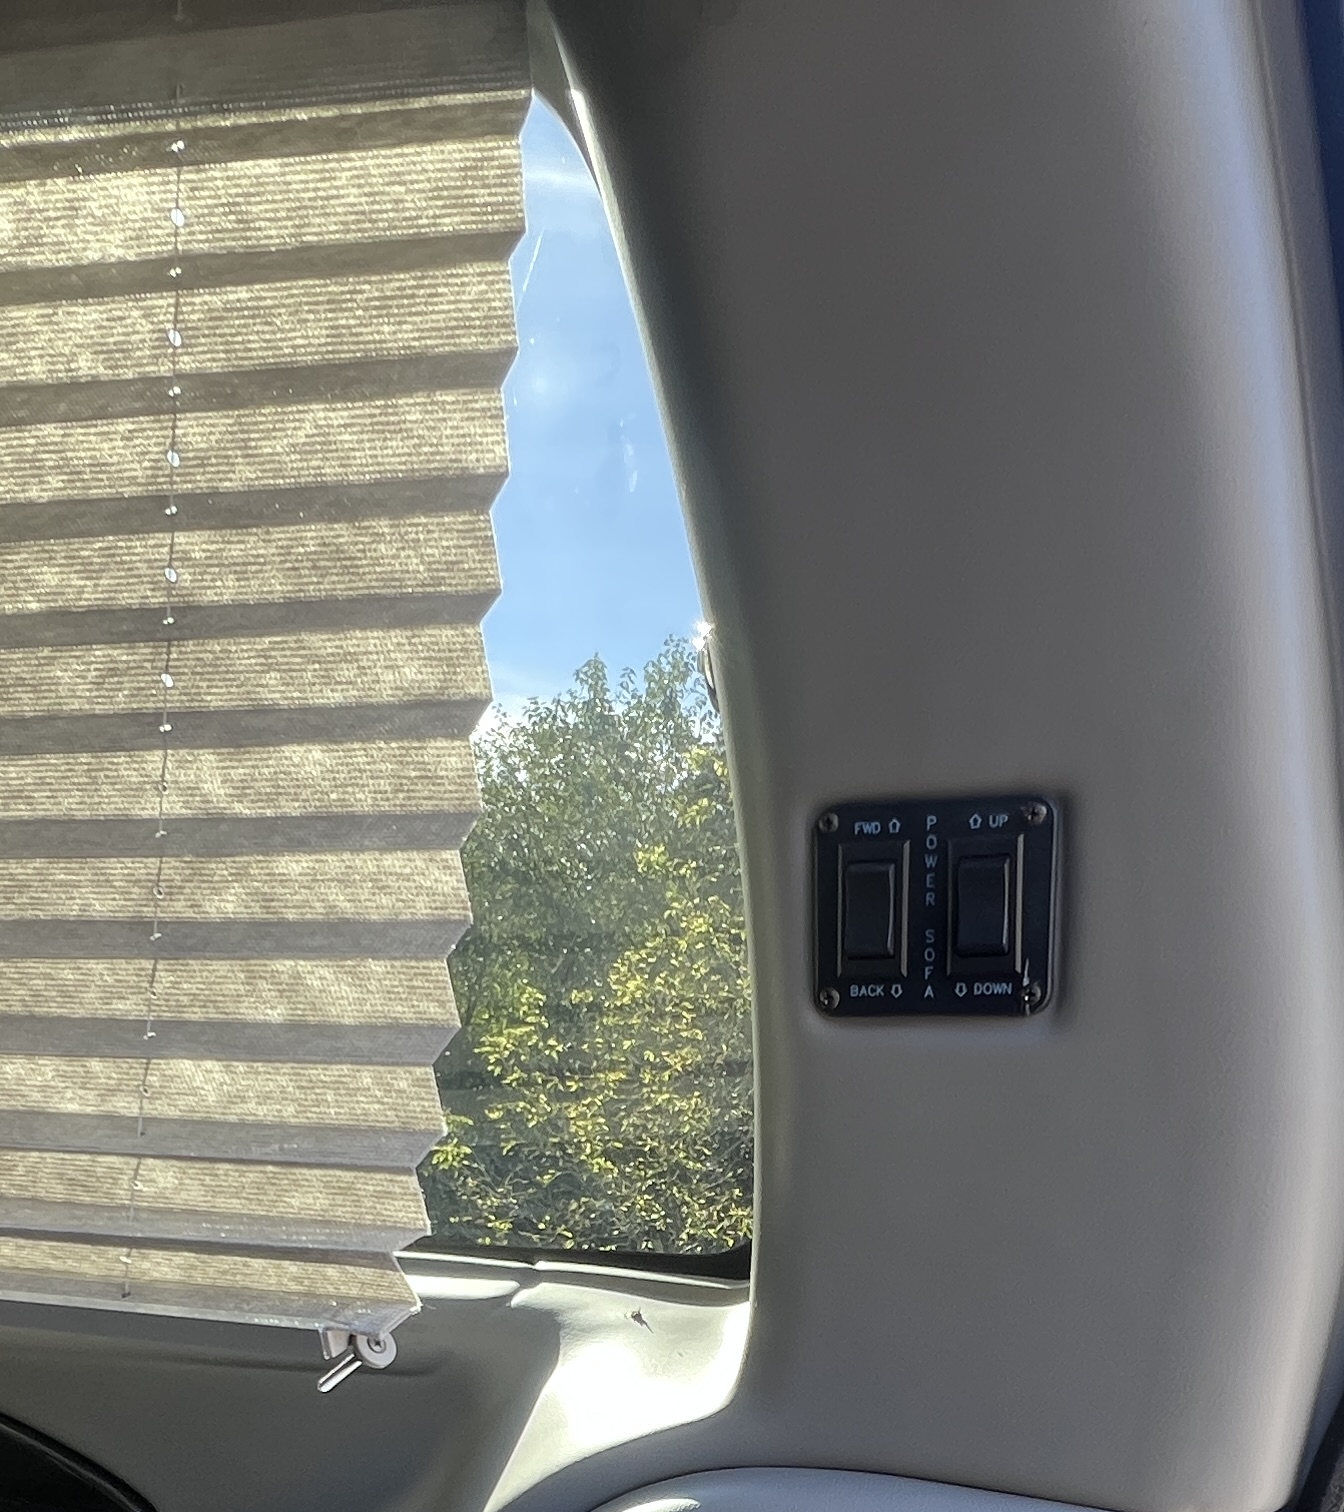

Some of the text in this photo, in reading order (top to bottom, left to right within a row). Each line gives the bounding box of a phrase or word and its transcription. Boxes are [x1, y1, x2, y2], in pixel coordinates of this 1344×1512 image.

[854, 820, 881, 835] FWD
[988, 814, 1009, 828] UP
[924, 815, 938, 998] POWER SOFA
[850, 984, 884, 997] BACK
[973, 982, 1012, 996] DOWN
